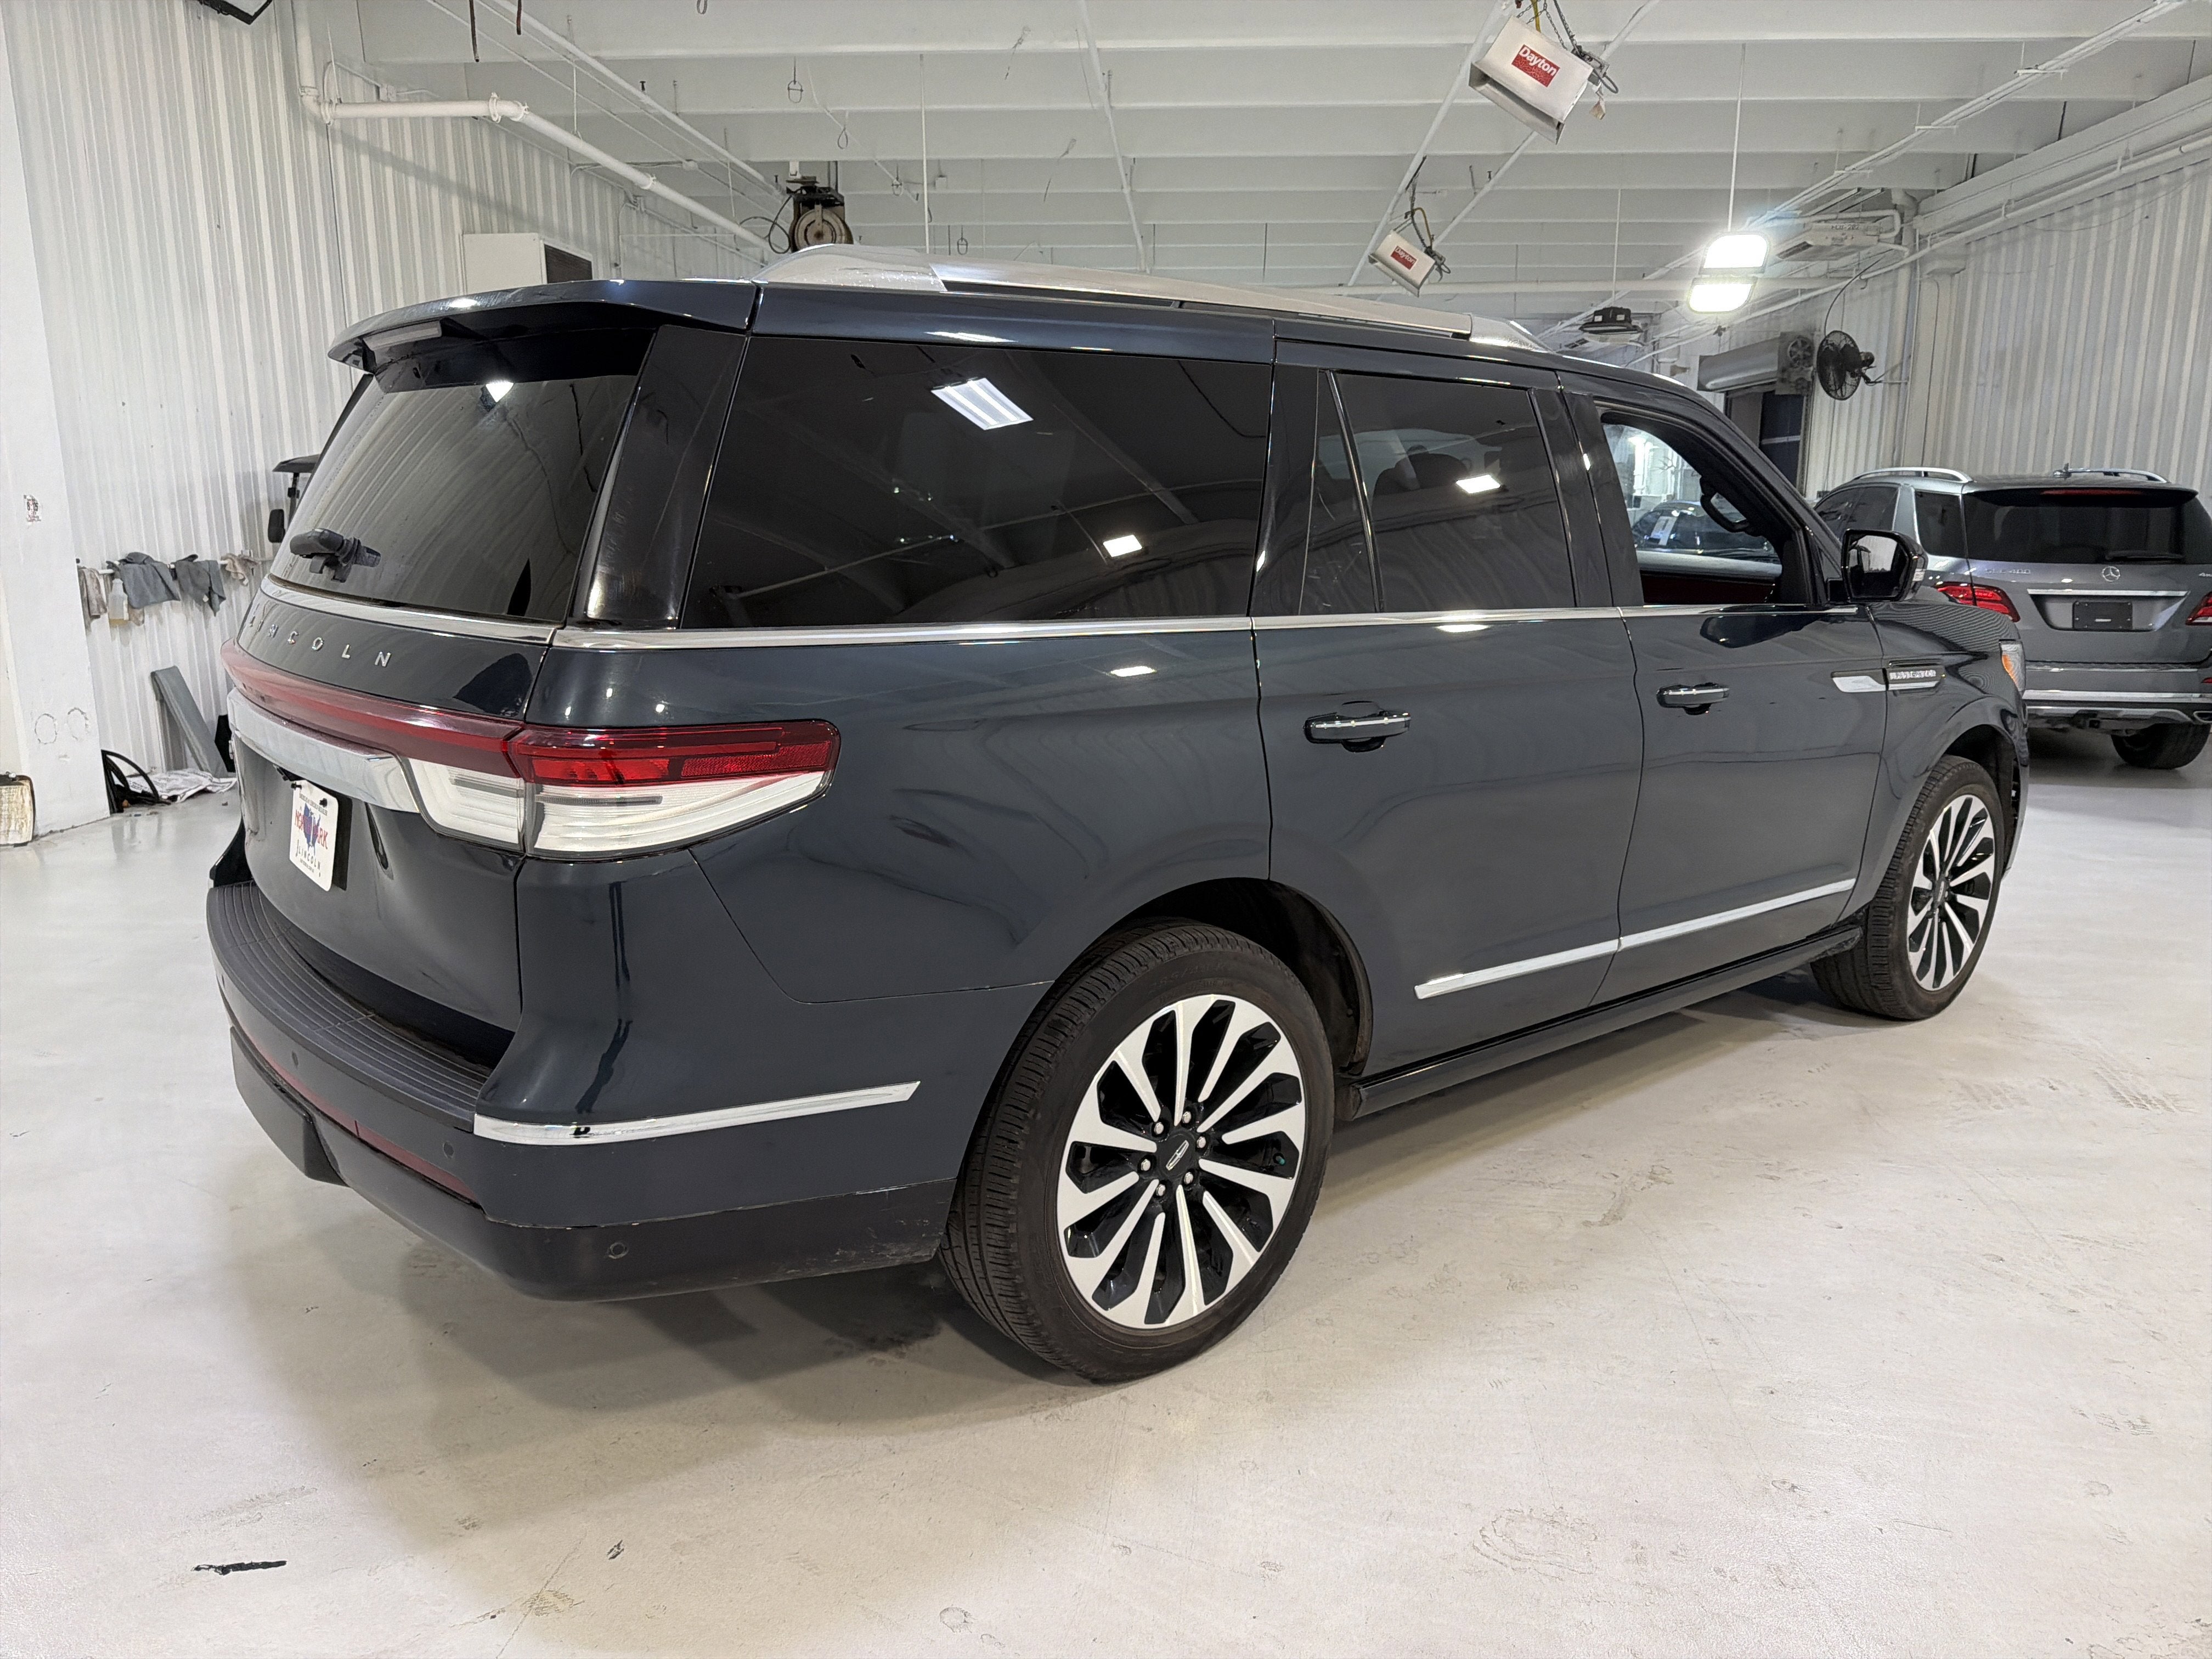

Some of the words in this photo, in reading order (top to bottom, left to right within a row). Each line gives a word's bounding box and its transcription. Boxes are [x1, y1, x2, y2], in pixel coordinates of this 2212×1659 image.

[1519, 47, 1557, 76] Dayton
[1395, 247, 1415, 264] Dayton
[249, 615, 392, 668] LINCOLN
[298, 845, 321, 870] LINCOLN
